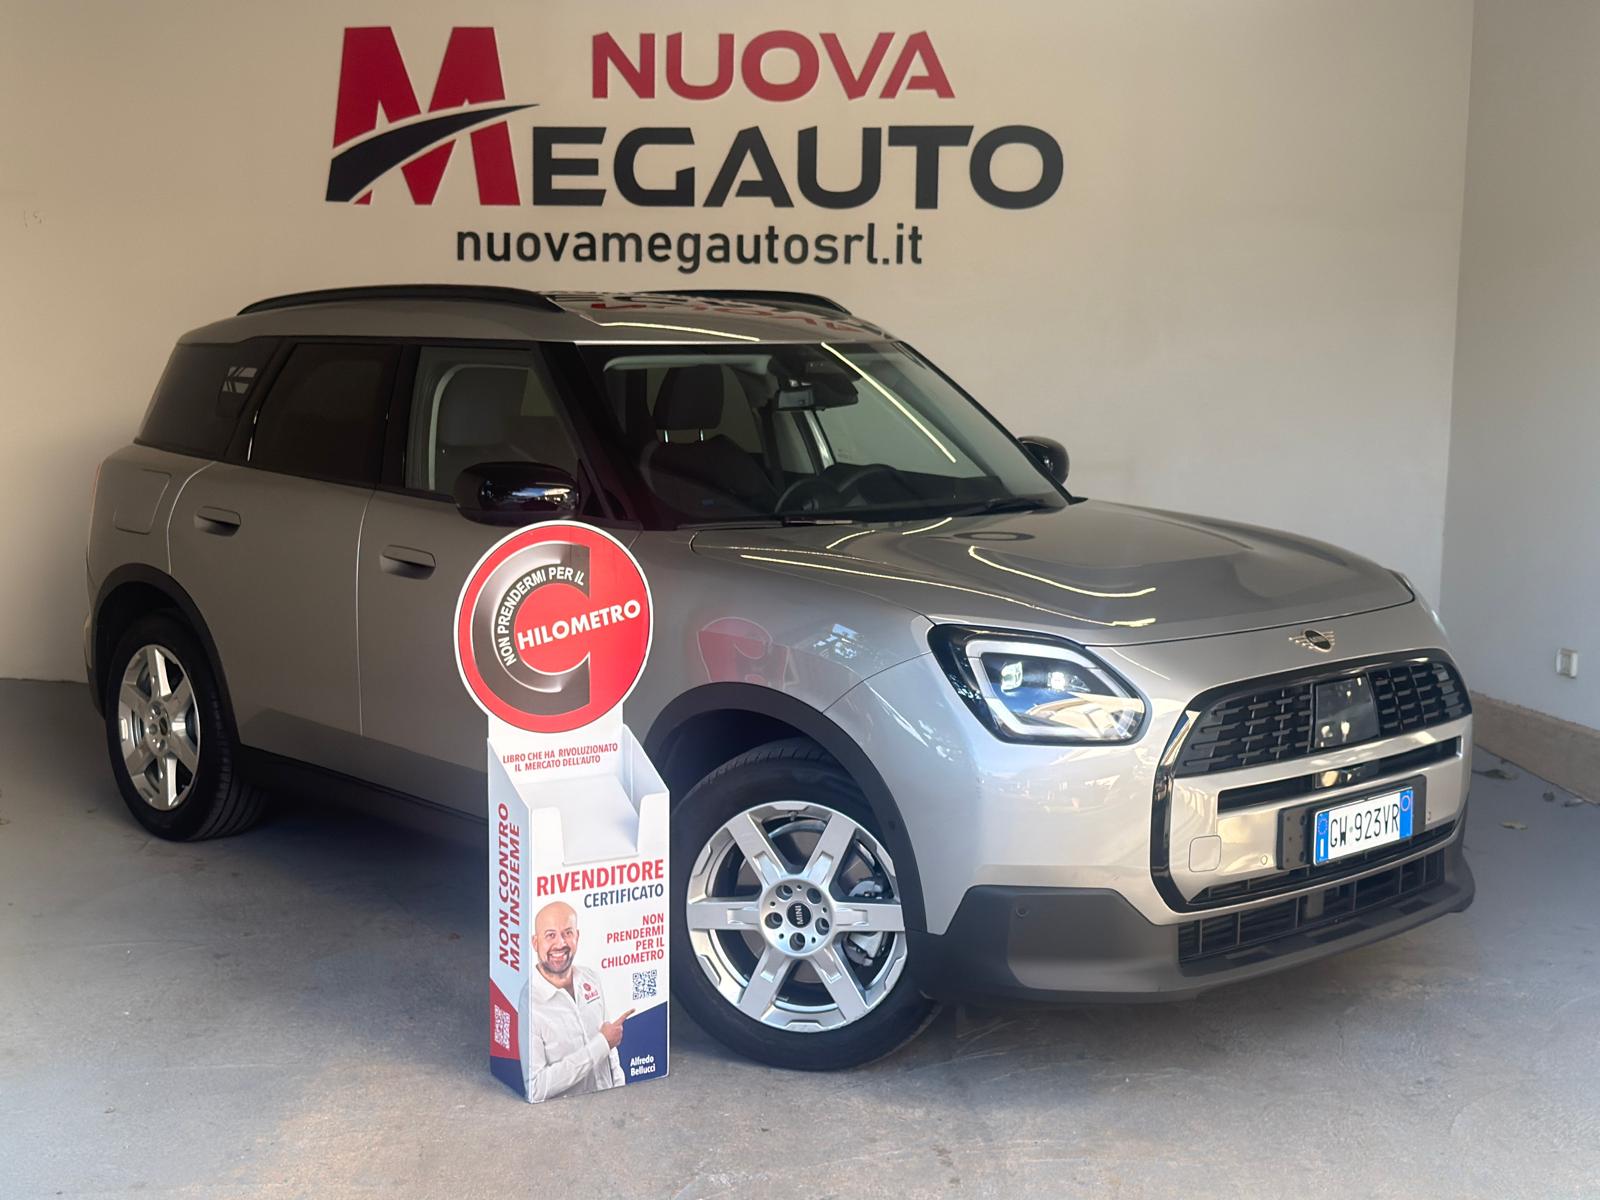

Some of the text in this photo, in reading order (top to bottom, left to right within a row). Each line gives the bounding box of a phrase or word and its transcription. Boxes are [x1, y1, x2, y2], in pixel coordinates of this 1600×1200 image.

[592, 30, 956, 101] NUOVA
[456, 223, 924, 274] nuovamegautosrl.it
[497, 566, 585, 667] NON PRENDERMI PER IL
[503, 743, 618, 764] LIBRO CHE HA RIVOLUZIONATO
[514, 755, 601, 773] IL MERCATO DELL'AUTO
[498, 803, 509, 965] NON CONTRO
[536, 859, 664, 897] RIVENDITORE
[510, 822, 520, 972] MA INSIEME
[584, 883, 664, 908] CERTIFICATO
[642, 913, 664, 925] NON
[606, 924, 664, 943] PRENDERMI
[635, 935, 664, 951] PER IL
[601, 949, 664, 969] CHILOMETRO
[630, 1054, 654, 1068] Alfredo
[630, 1064, 656, 1077] Bellucci
